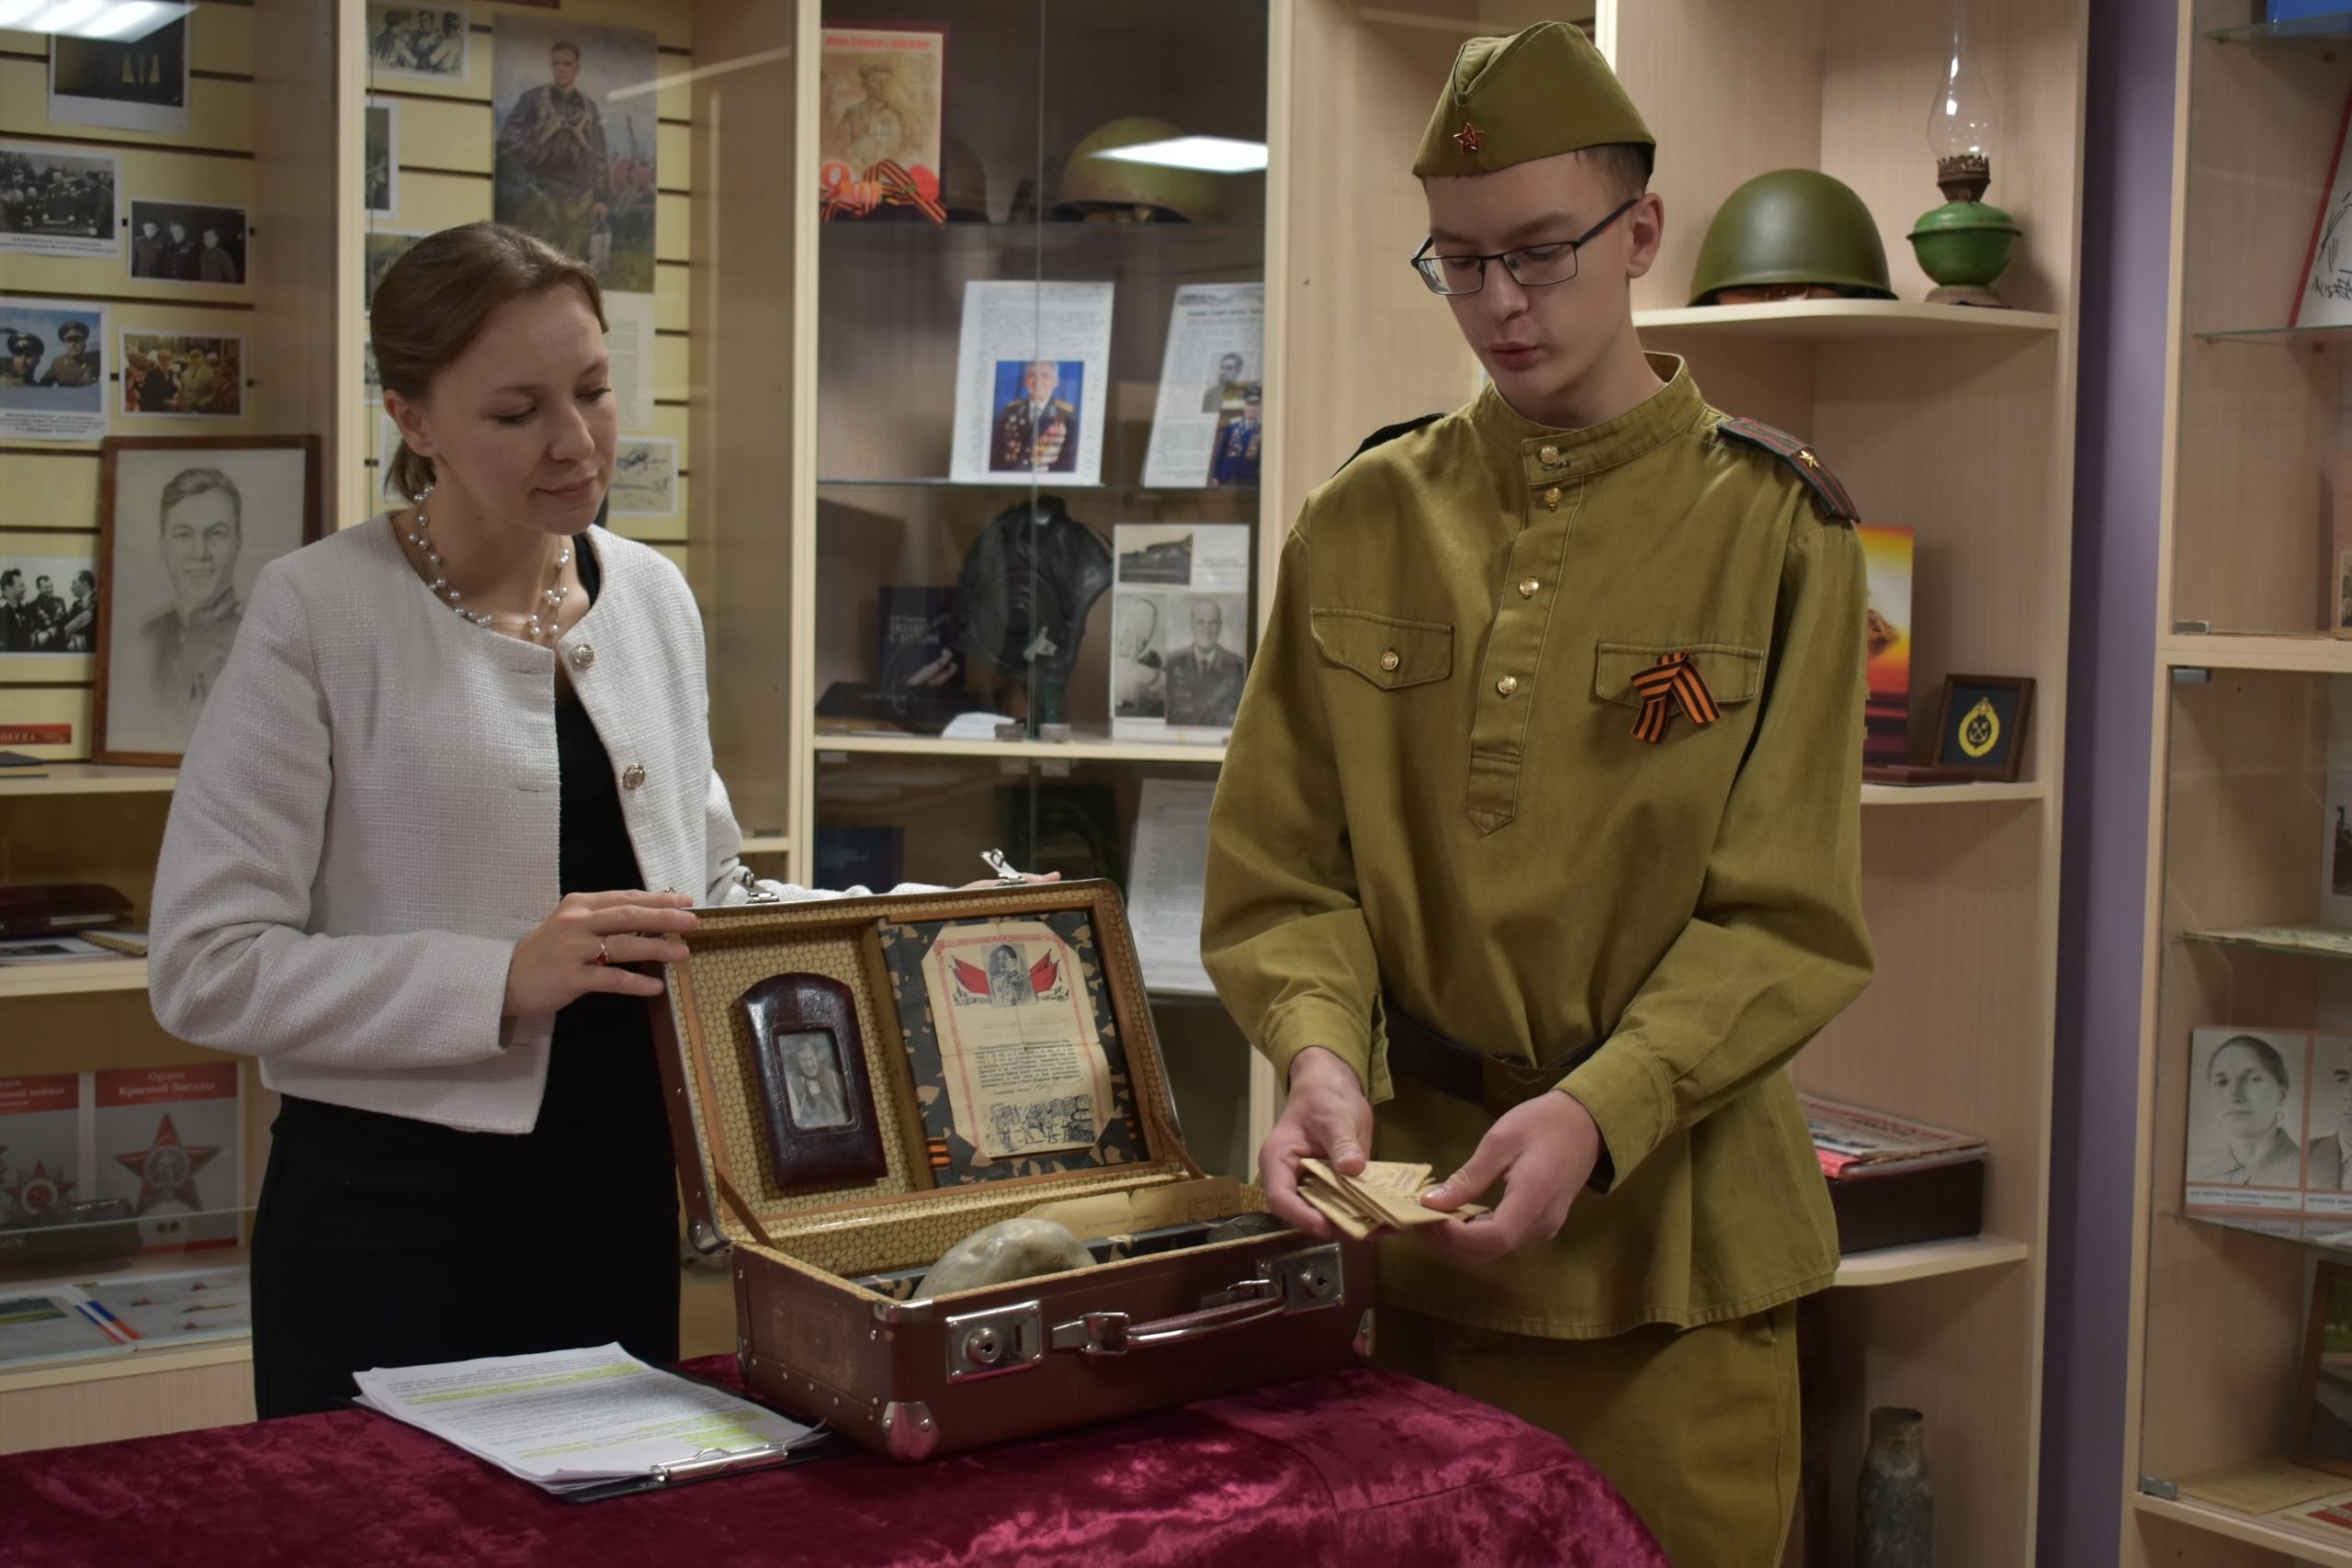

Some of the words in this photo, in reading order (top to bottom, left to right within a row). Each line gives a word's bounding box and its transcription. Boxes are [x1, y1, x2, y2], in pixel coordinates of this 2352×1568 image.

[0, 733, 36, 743] ОБЕДА
[148, 1071, 186, 1082] Орден
[119, 1081, 169, 1098] Красной
